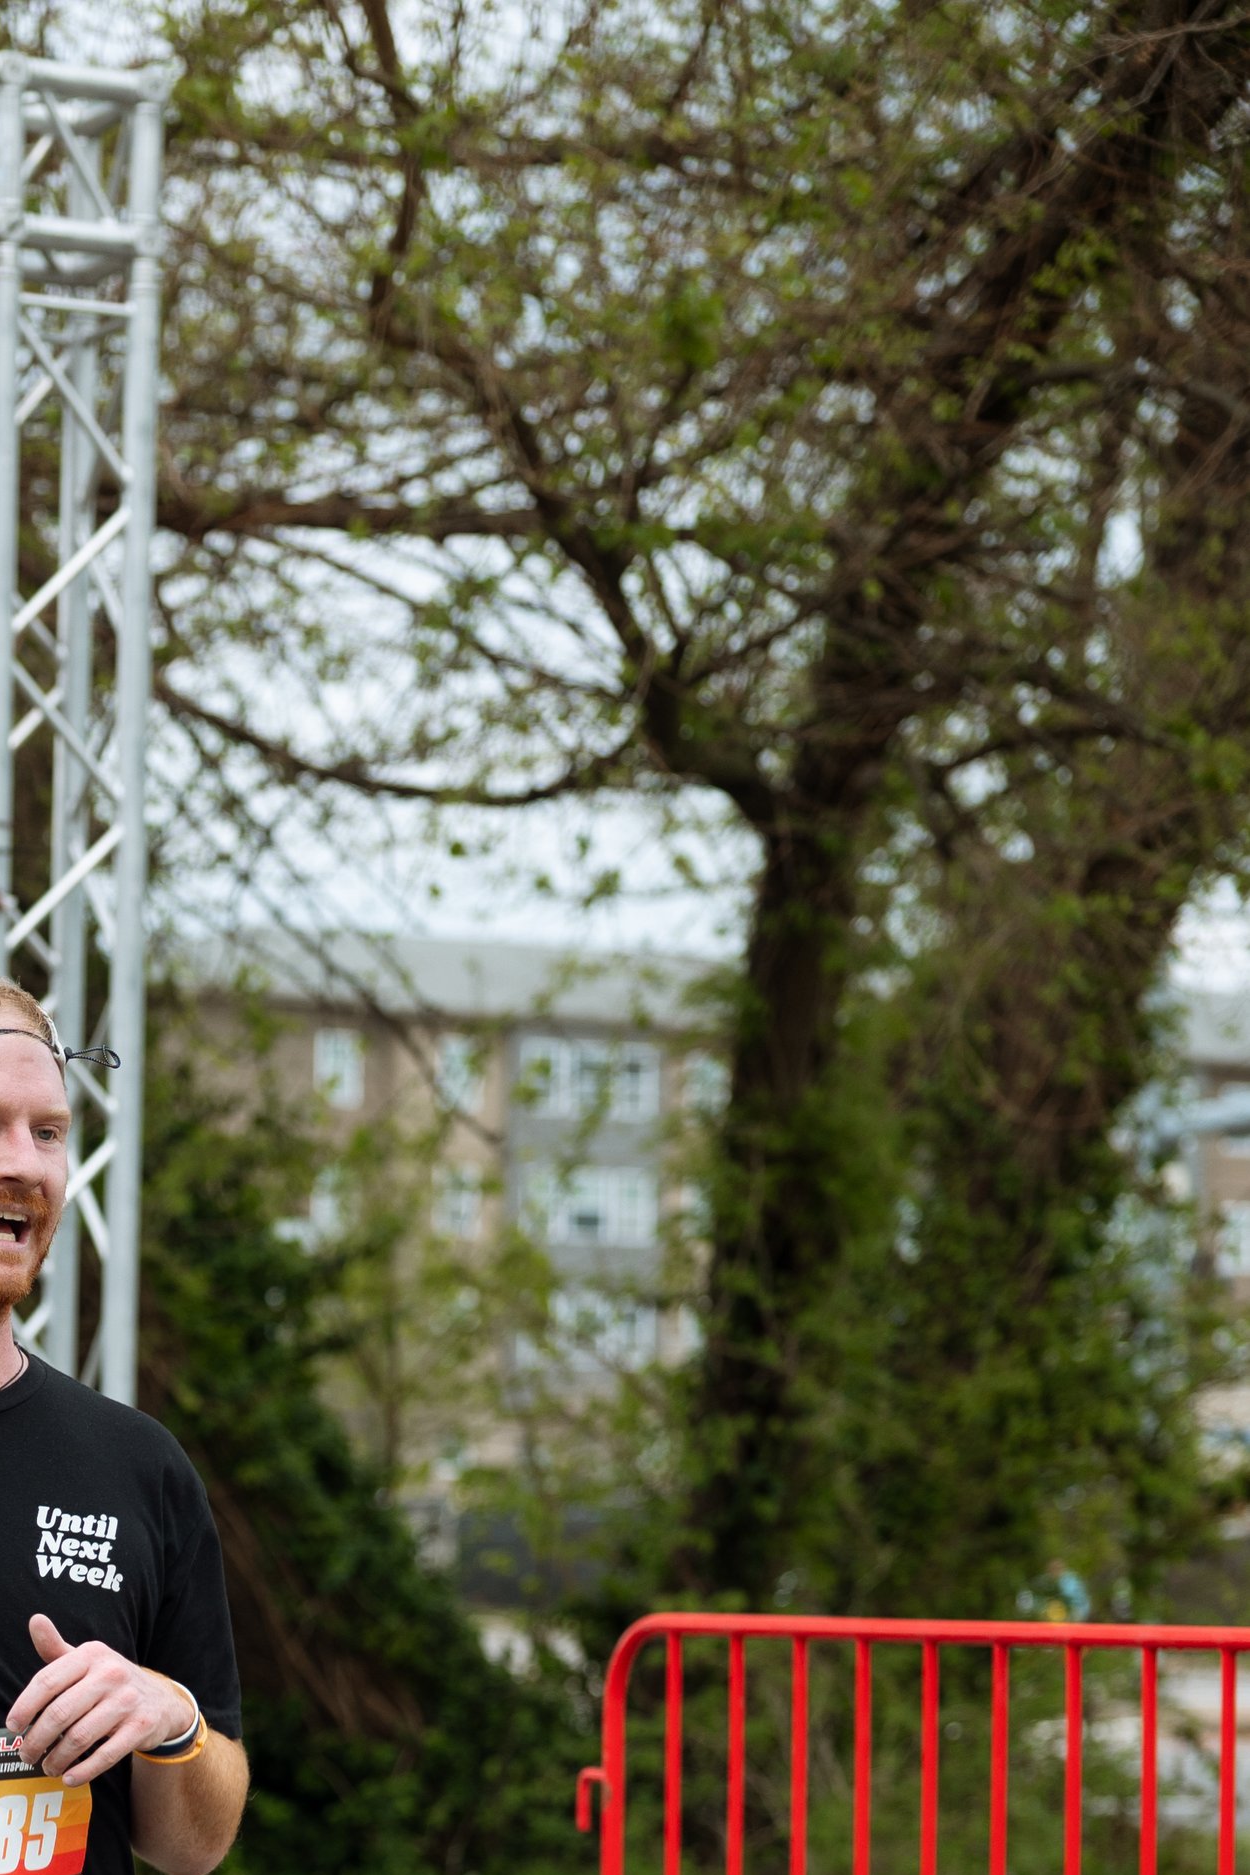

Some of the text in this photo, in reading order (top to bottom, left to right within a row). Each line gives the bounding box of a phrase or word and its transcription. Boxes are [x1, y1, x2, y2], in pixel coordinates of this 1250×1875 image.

[36, 1505, 119, 1541] Until
[36, 1530, 113, 1563] Next
[35, 1554, 124, 1592] Week
